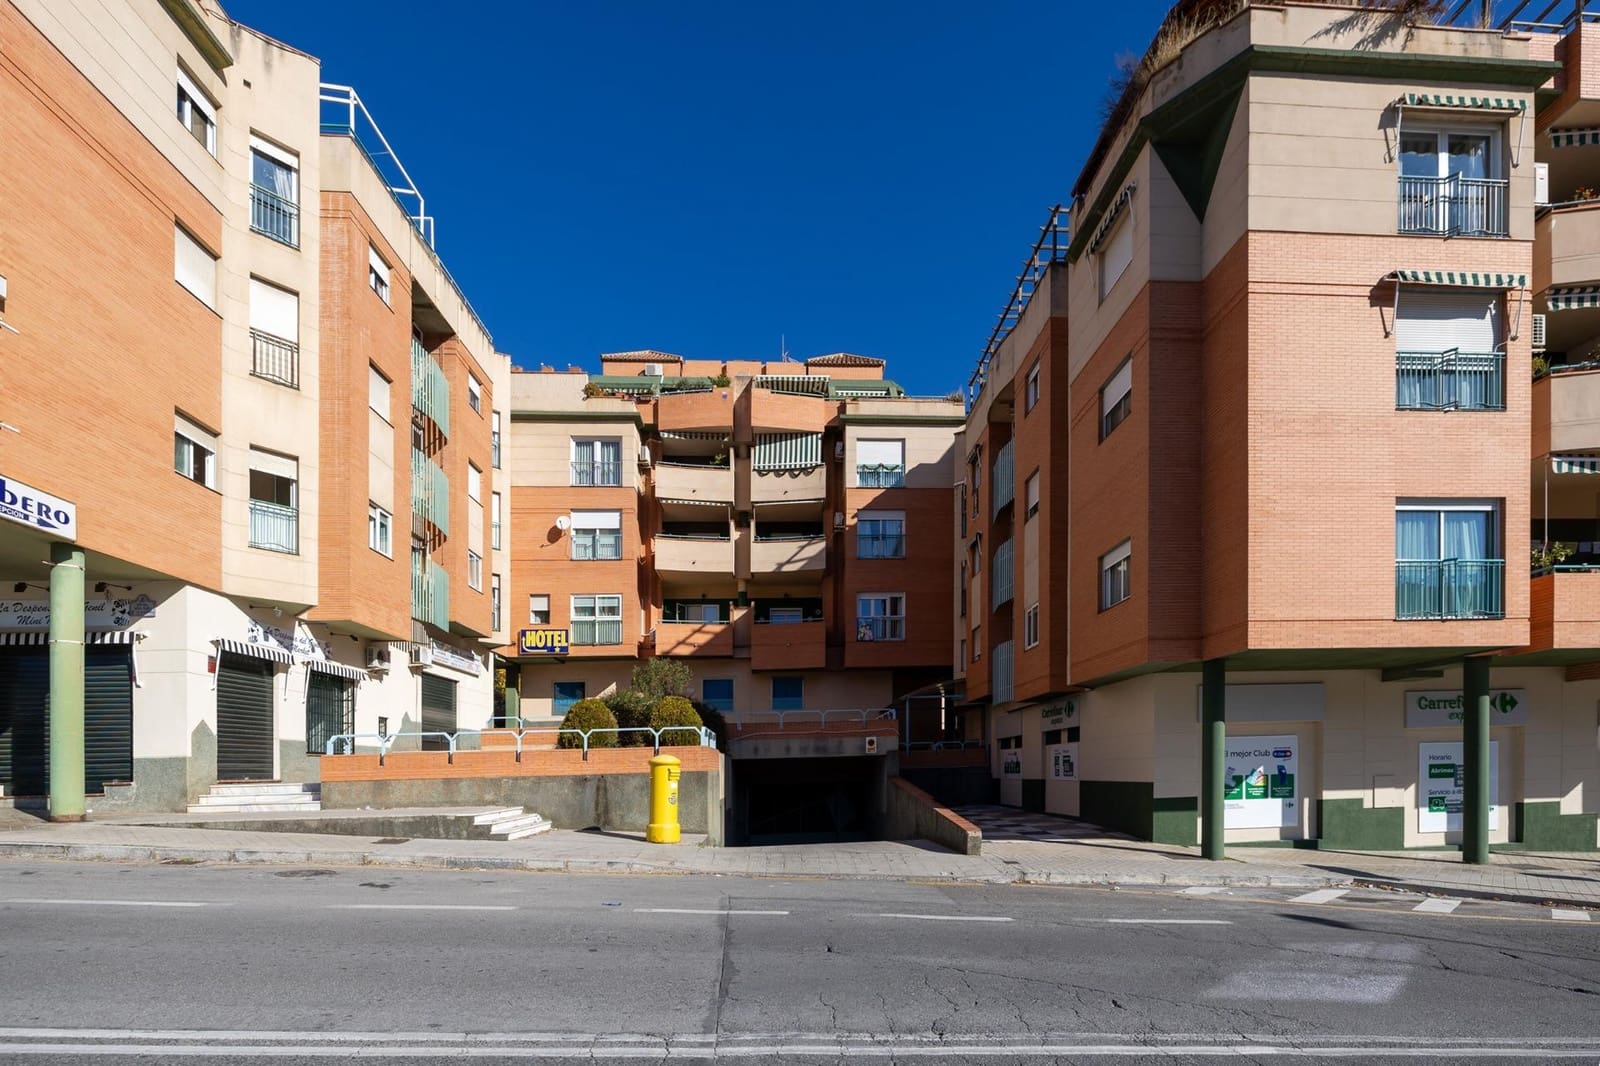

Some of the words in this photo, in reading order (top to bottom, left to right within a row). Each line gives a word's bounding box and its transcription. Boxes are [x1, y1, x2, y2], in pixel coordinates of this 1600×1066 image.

[13, 602, 50, 615] Despen
[526, 630, 568, 647] HOTEL
[1418, 695, 1464, 710] Carref
[1230, 750, 1252, 759] mejor
[1253, 749, 1271, 757] Club
